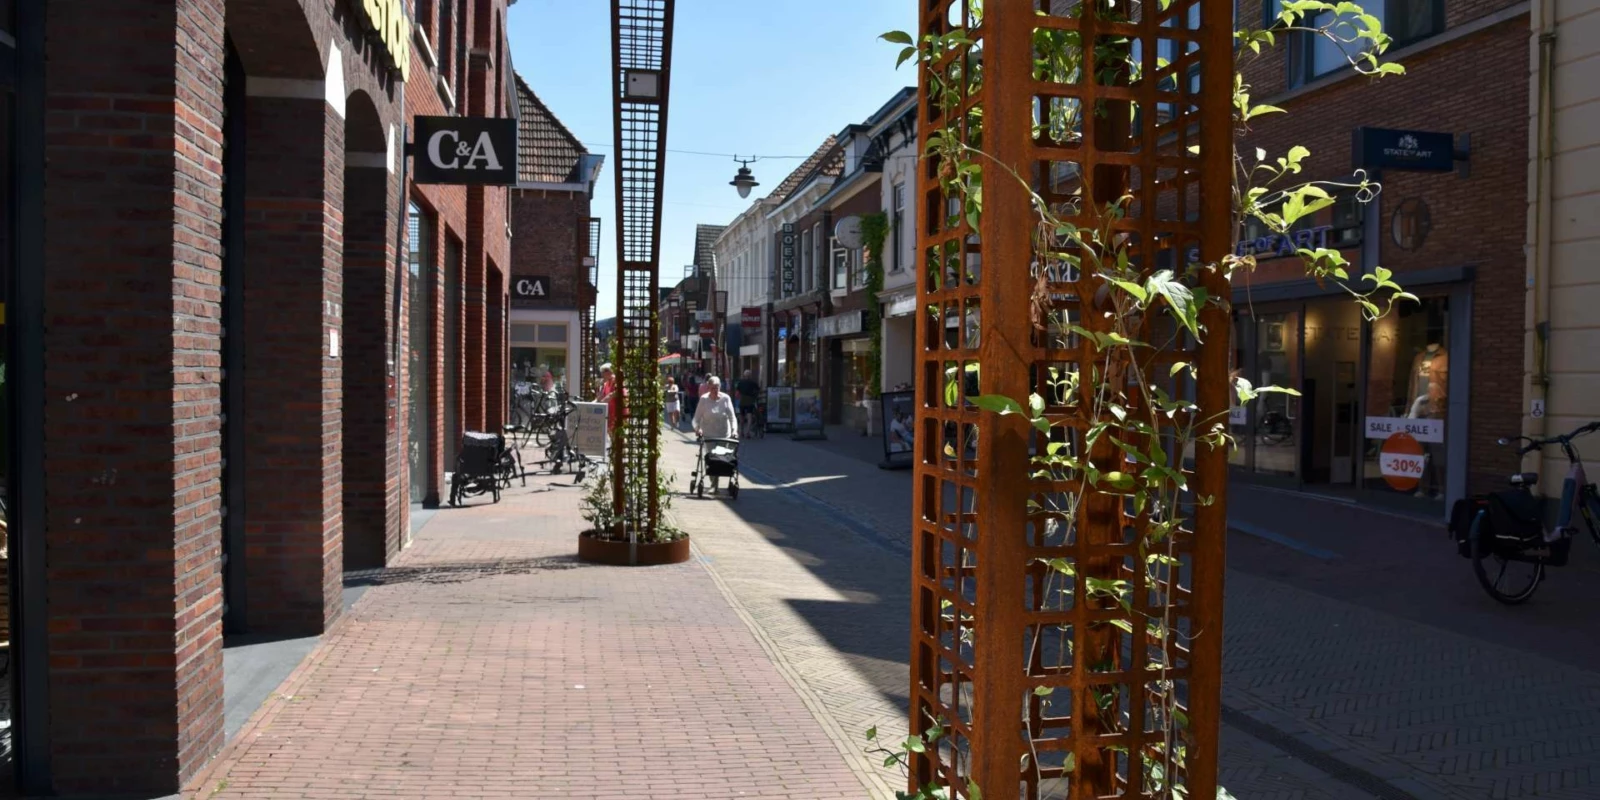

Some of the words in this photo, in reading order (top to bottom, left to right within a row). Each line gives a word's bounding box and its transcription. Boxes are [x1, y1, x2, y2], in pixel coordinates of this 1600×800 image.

[427, 129, 503, 171] C&A
[1383, 147, 1409, 157] STATE
[1416, 150, 1433, 159] ART
[1275, 225, 1333, 257] ART
[784, 224, 793, 292] BOEKEN
[516, 279, 545, 297] C&A
[1370, 422, 1392, 432] SALE
[1405, 424, 1429, 435] SALE
[1386, 458, 1422, 474] -30%
